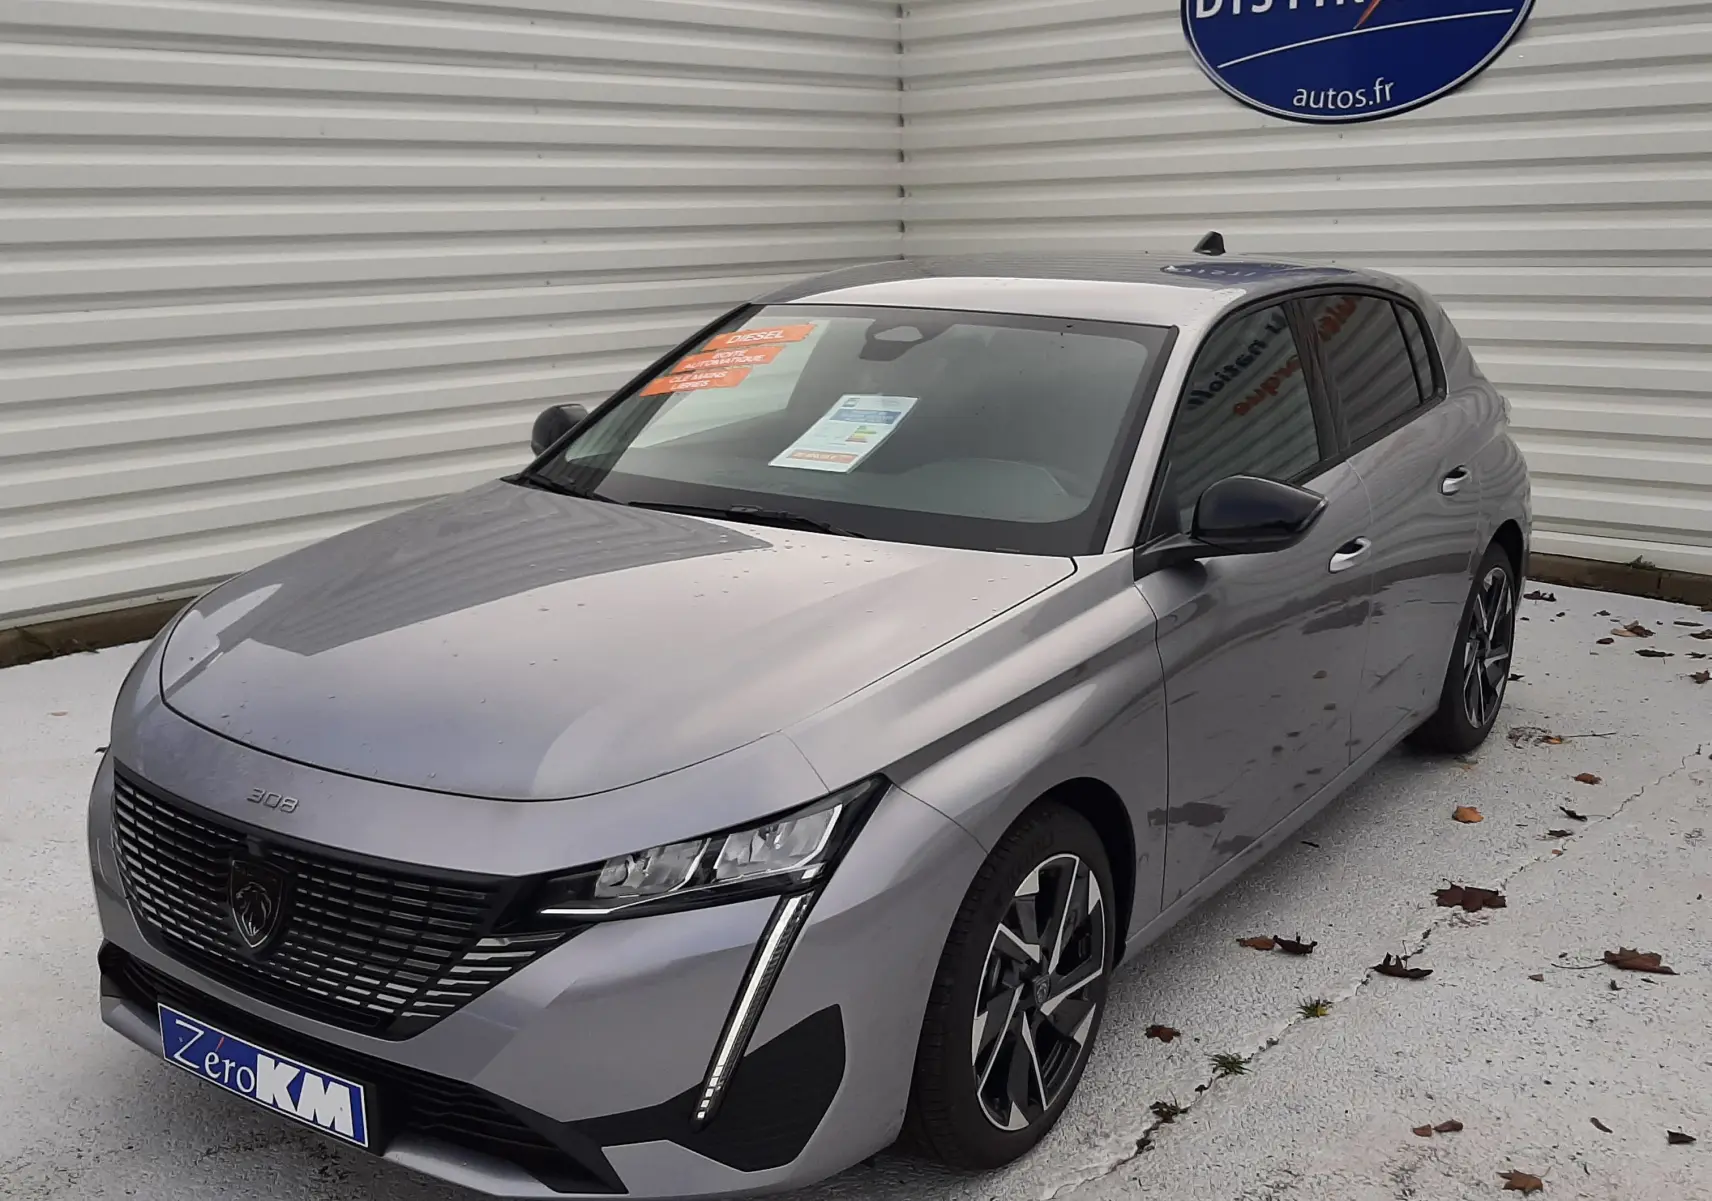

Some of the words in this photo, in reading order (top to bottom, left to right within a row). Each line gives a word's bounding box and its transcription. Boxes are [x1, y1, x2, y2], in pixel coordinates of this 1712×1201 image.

[1293, 77, 1394, 109] autos.fr
[725, 329, 785, 344] DIESEL
[247, 787, 299, 813] 308
